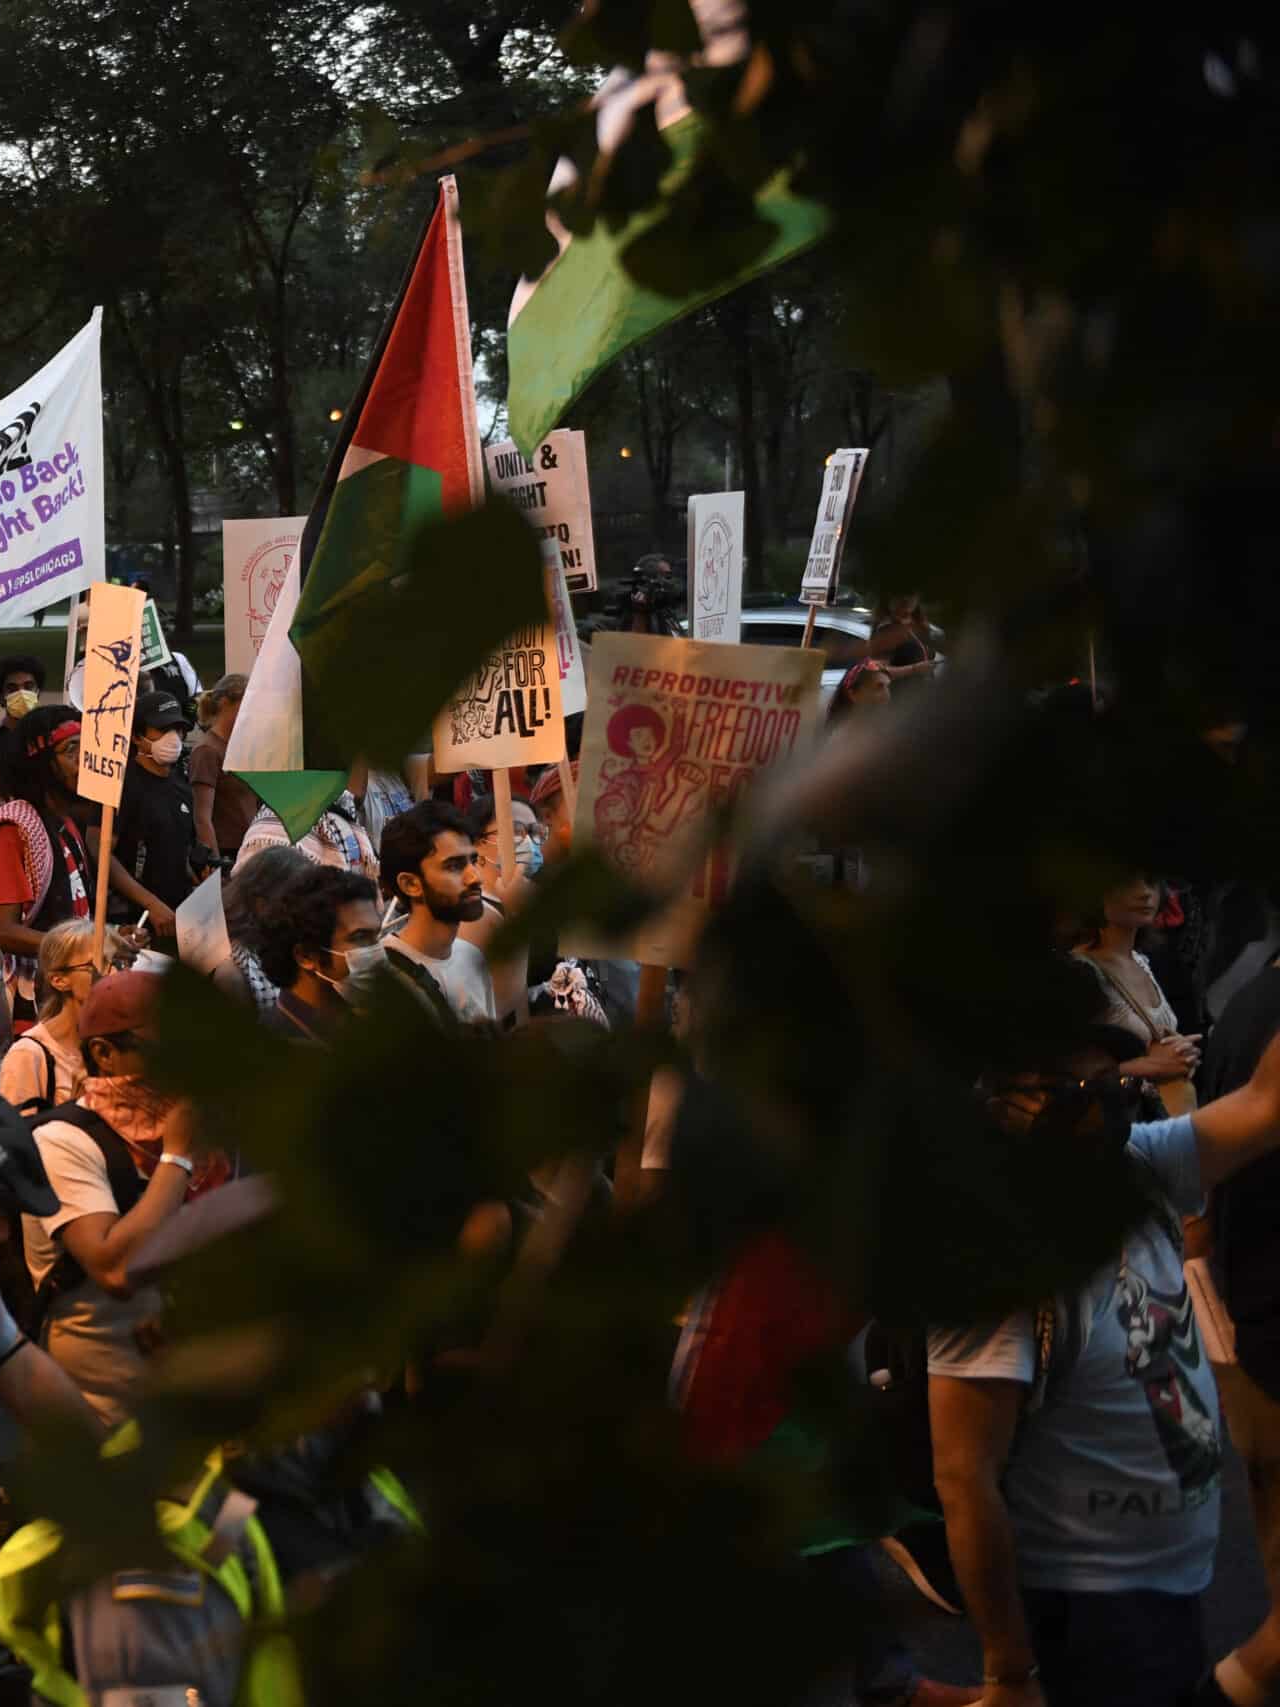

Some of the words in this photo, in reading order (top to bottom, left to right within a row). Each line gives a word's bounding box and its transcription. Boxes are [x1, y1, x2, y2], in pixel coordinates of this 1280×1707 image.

[19, 442, 79, 493] Back
[540, 445, 557, 470] &
[32, 469, 86, 524] Back!
[502, 649, 546, 689] FOR
[493, 686, 552, 738] ALL!
[683, 699, 801, 766] FREEDOM
